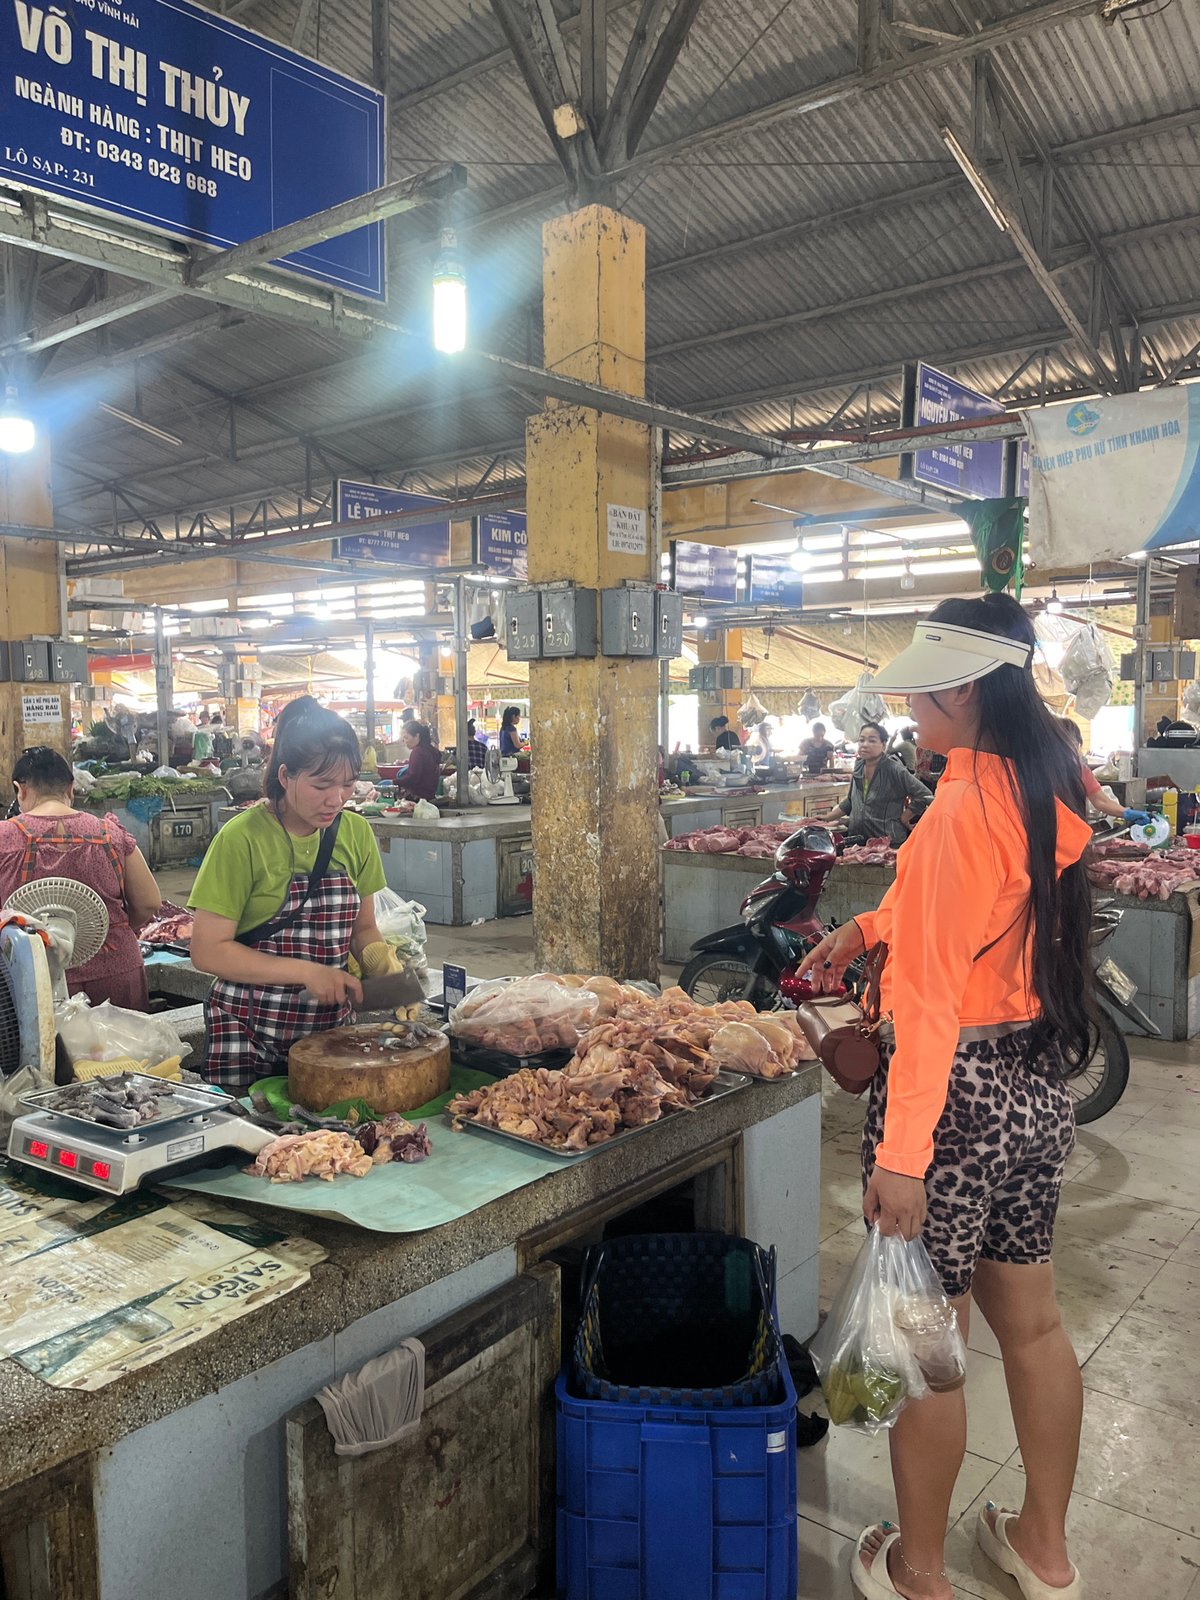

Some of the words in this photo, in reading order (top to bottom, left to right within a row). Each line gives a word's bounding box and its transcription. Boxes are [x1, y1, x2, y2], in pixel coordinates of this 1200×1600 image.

[75, 0, 96, 12] HỢ
[97, 2, 121, 21] VĨNH
[123, 13, 139, 28] HẢI
[14, 0, 72, 65] VÕ
[85, 30, 147, 108] THỊ
[159, 61, 251, 137] THỦY
[14, 75, 84, 119] NGÀNH
[89, 104, 140, 141] HÀNG
[157, 124, 204, 165] THỊT
[211, 144, 252, 182] HEO
[5, 146, 28, 166] LÔ
[32, 156, 69, 181] SẠP:
[72, 168, 95, 188] 231
[60, 126, 91, 153] ĐT:
[96, 140, 143, 171] 0343
[148, 158, 181, 185] 028
[185, 172, 217, 198] 668
[1057, 451, 1074, 468] HIỆP
[1076, 446, 1092, 462] PHỤ
[1094, 441, 1106, 457] NỮ
[1107, 434, 1127, 453] TỈNH
[1129, 426, 1159, 446] KHÁNH
[1162, 419, 1181, 438] HÒA
[347, 502, 361, 519] LÊ
[397, 531, 410, 541] HEO
[491, 528, 511, 543] KIM
[513, 634, 535, 650] 229
[548, 632, 570, 647] 230
[632, 634, 650, 649] 220
[662, 635, 677, 649] 219
[174, 824, 192, 835] 170
[175, 1260, 282, 1310] SAIGON
[226, 1282, 261, 1299] BIA
